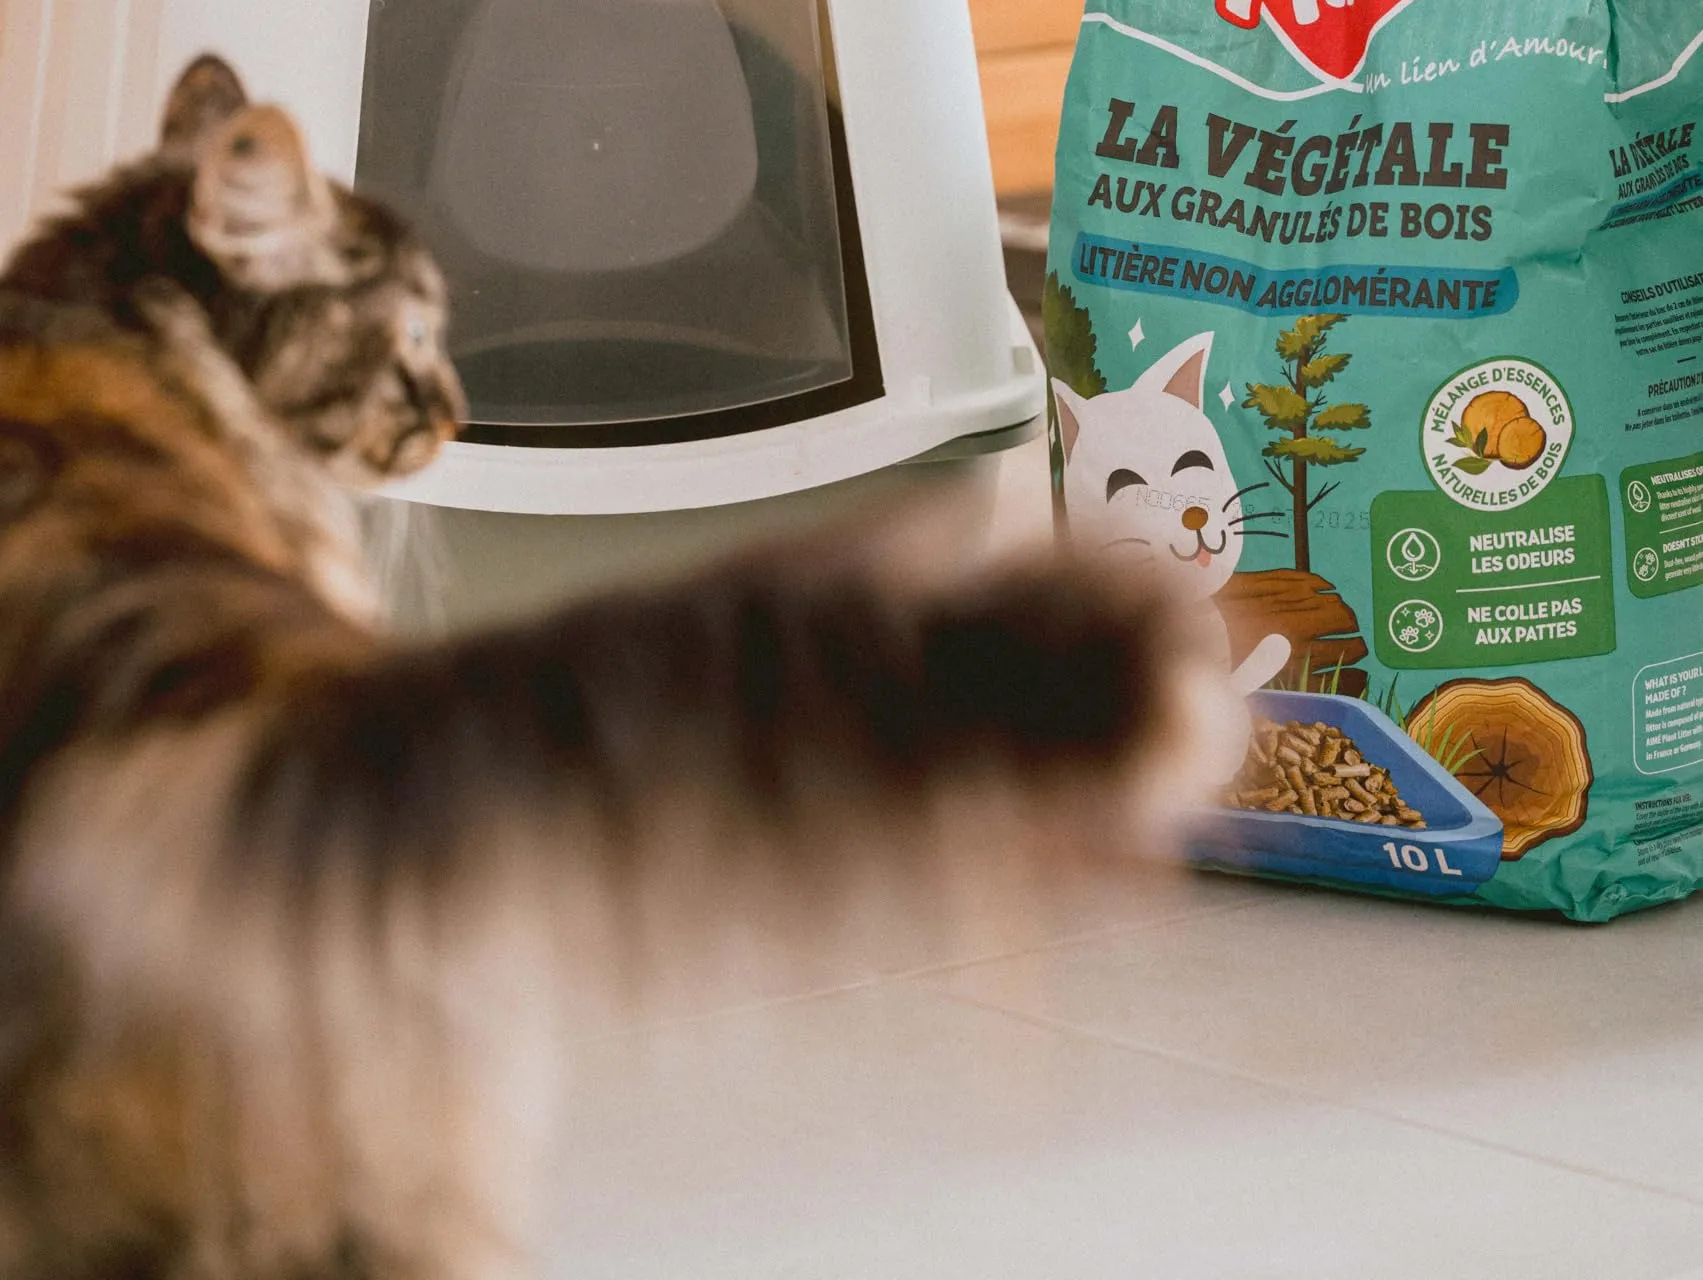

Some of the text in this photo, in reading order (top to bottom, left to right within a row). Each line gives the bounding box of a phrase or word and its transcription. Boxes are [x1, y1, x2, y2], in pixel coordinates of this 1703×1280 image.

[1095, 97, 1510, 197] LA VÉGÉTALE
[1609, 146, 1632, 177] LA
[1087, 174, 1492, 245] AUX GRANULÉS DE BOIS
[1079, 243, 1500, 311] LITIÈRE NON AGGLOMÉRANTE
[1620, 287, 1655, 304] CONSEILS
[1431, 367, 1565, 432] MÉLANGE D'ESSENCES
[1432, 442, 1562, 506] NATURELLES DE BOIS
[1313, 510, 1370, 529] 2025
[1469, 525, 1575, 552] NEUTRALISE
[1471, 547, 1575, 574] LES ODEURS
[1467, 598, 1582, 623] NE COLLE PAS
[1475, 620, 1577, 645] AUX PATTES
[1645, 675, 1668, 690] WHAT
[1669, 673, 1677, 685] IS
[1678, 667, 1699, 682] YOUR
[1645, 689, 1670, 705] MADE
[1382, 842, 1462, 876] 10 L
